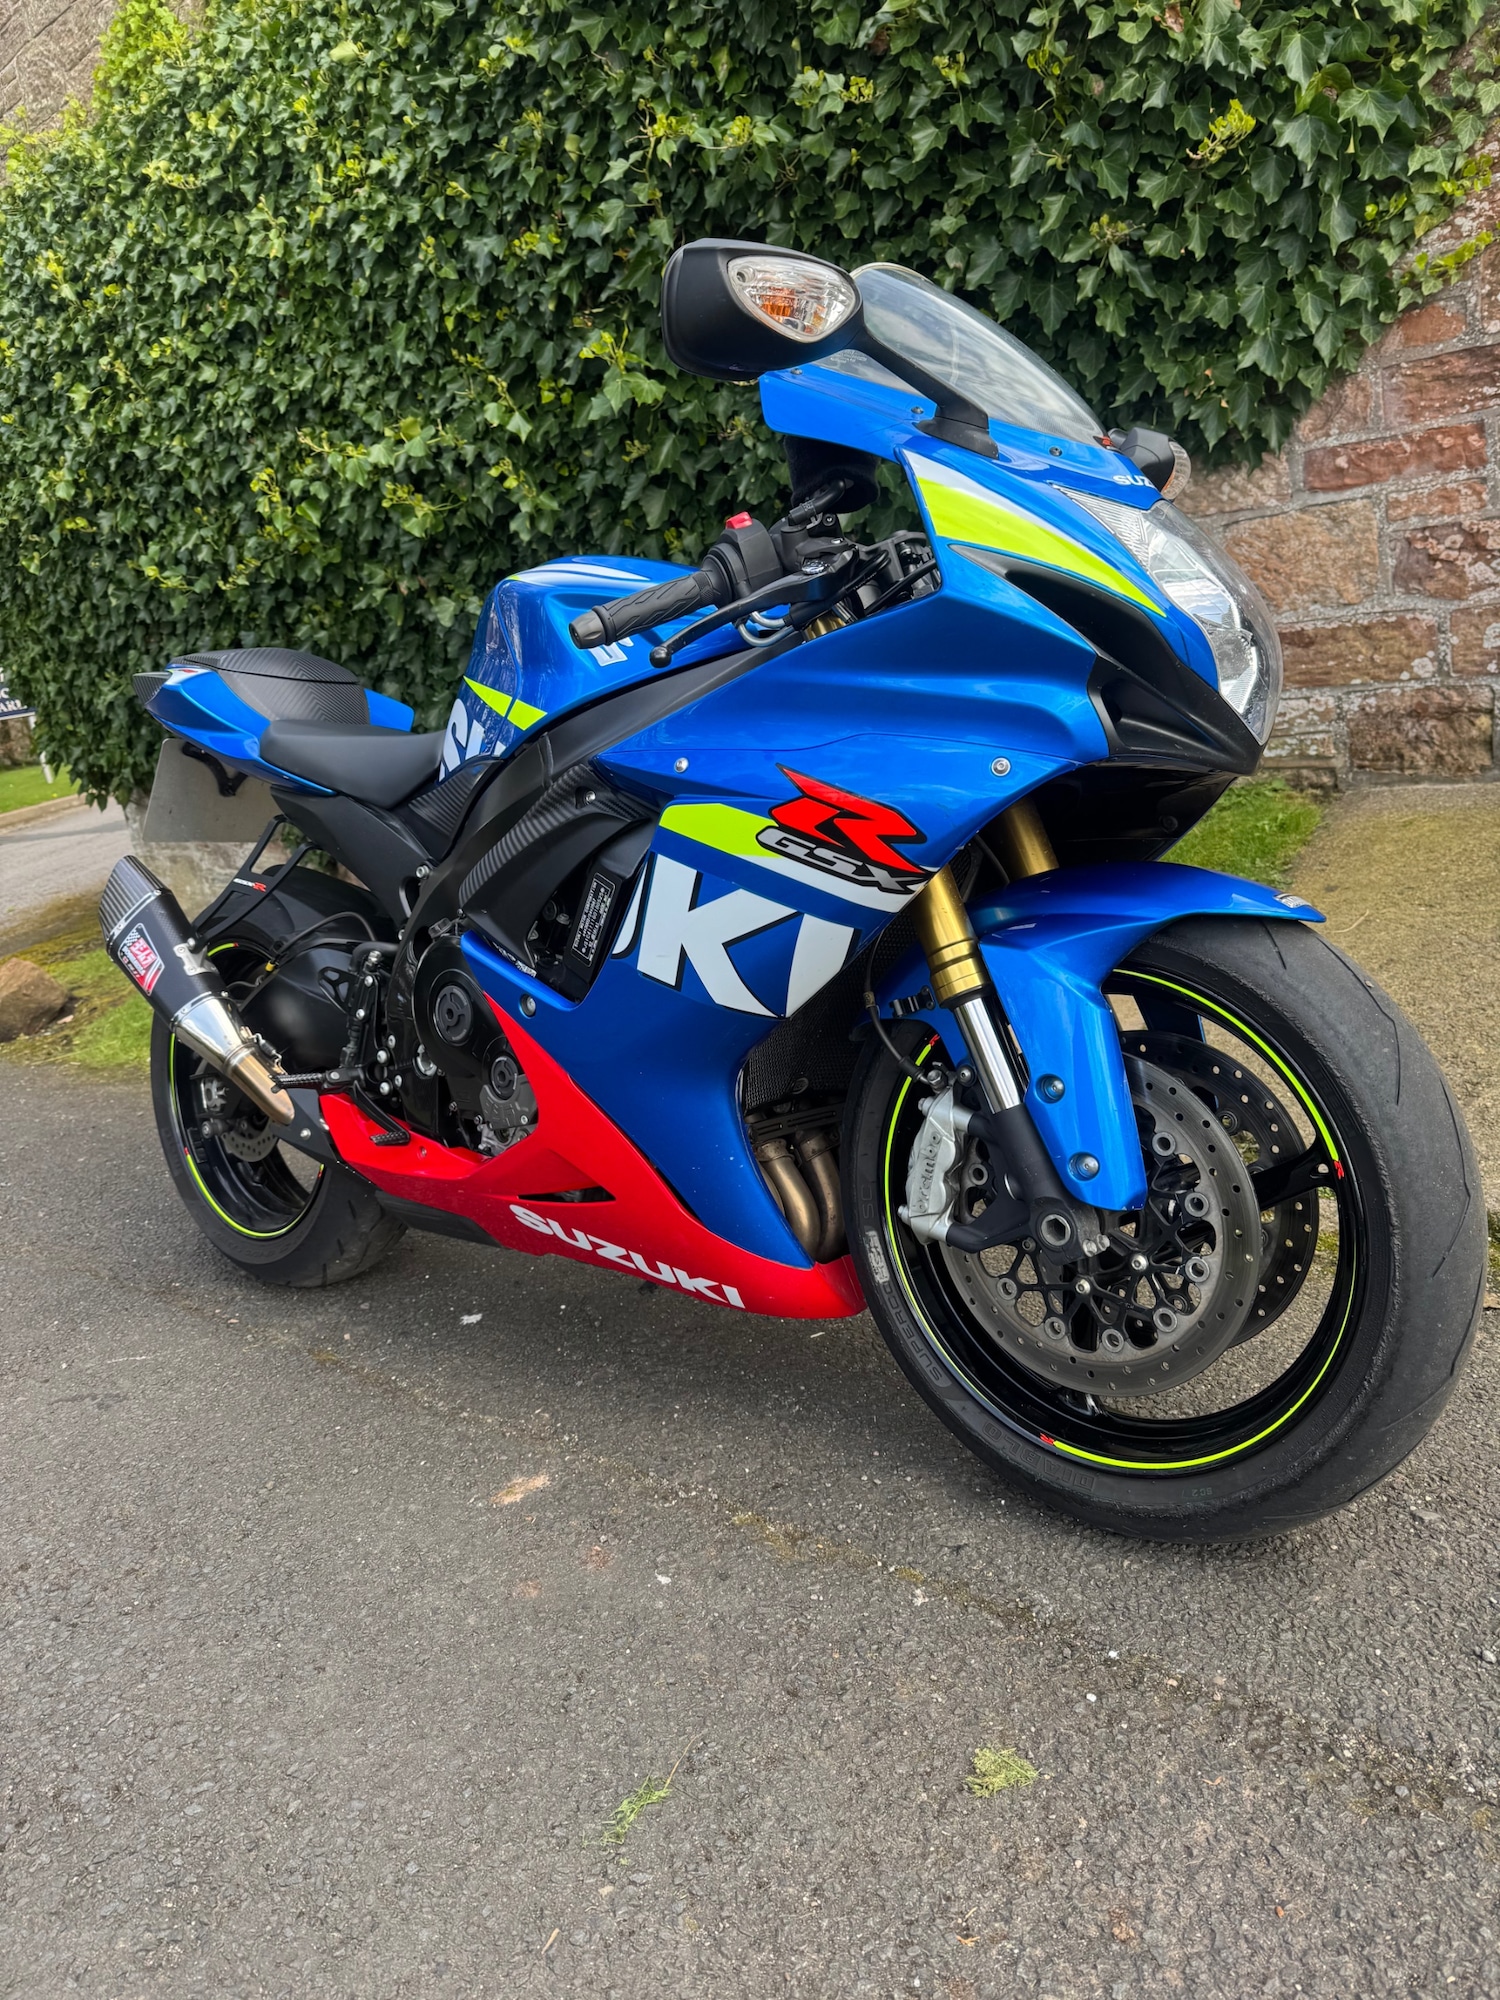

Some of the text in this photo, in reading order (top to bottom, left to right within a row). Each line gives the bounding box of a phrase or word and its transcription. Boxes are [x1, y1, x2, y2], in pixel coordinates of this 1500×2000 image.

[756, 827, 927, 892] GSX
[509, 1204, 746, 1309] SUZUKI
[982, 1422, 1095, 1491] DIABLO
